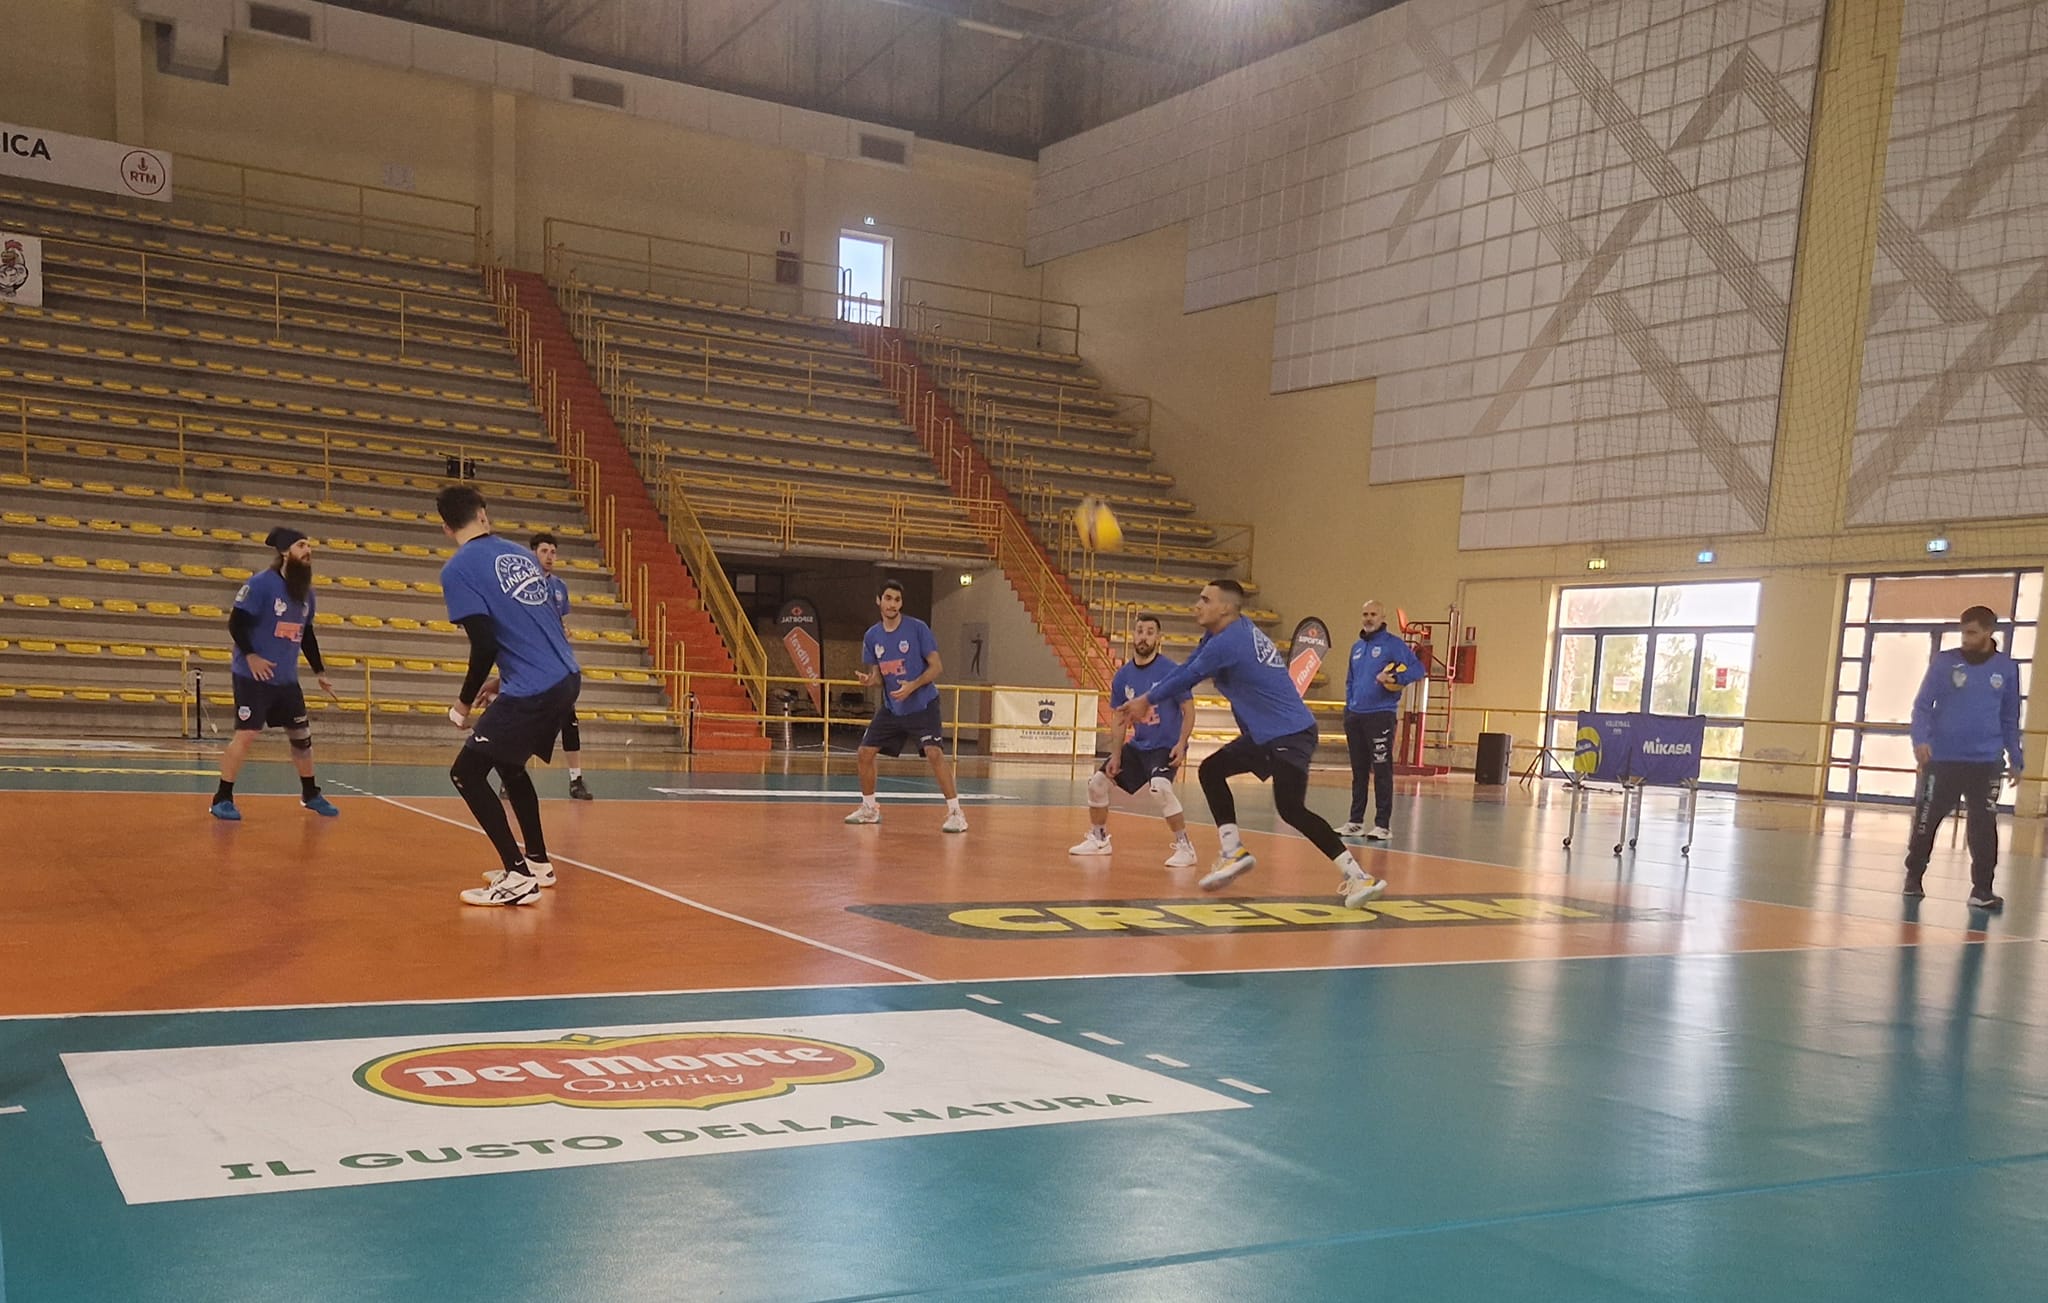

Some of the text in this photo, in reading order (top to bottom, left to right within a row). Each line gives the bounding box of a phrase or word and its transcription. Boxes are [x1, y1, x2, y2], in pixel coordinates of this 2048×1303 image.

[2, 131, 51, 162] ICA
[129, 170, 157, 185] RTM
[948, 898, 1600, 933] CREDEM
[404, 1047, 834, 1088] Del Monte
[563, 1072, 743, 1094] Quality
[221, 1091, 1152, 1180] IL GUSTO DELLA NATURA
